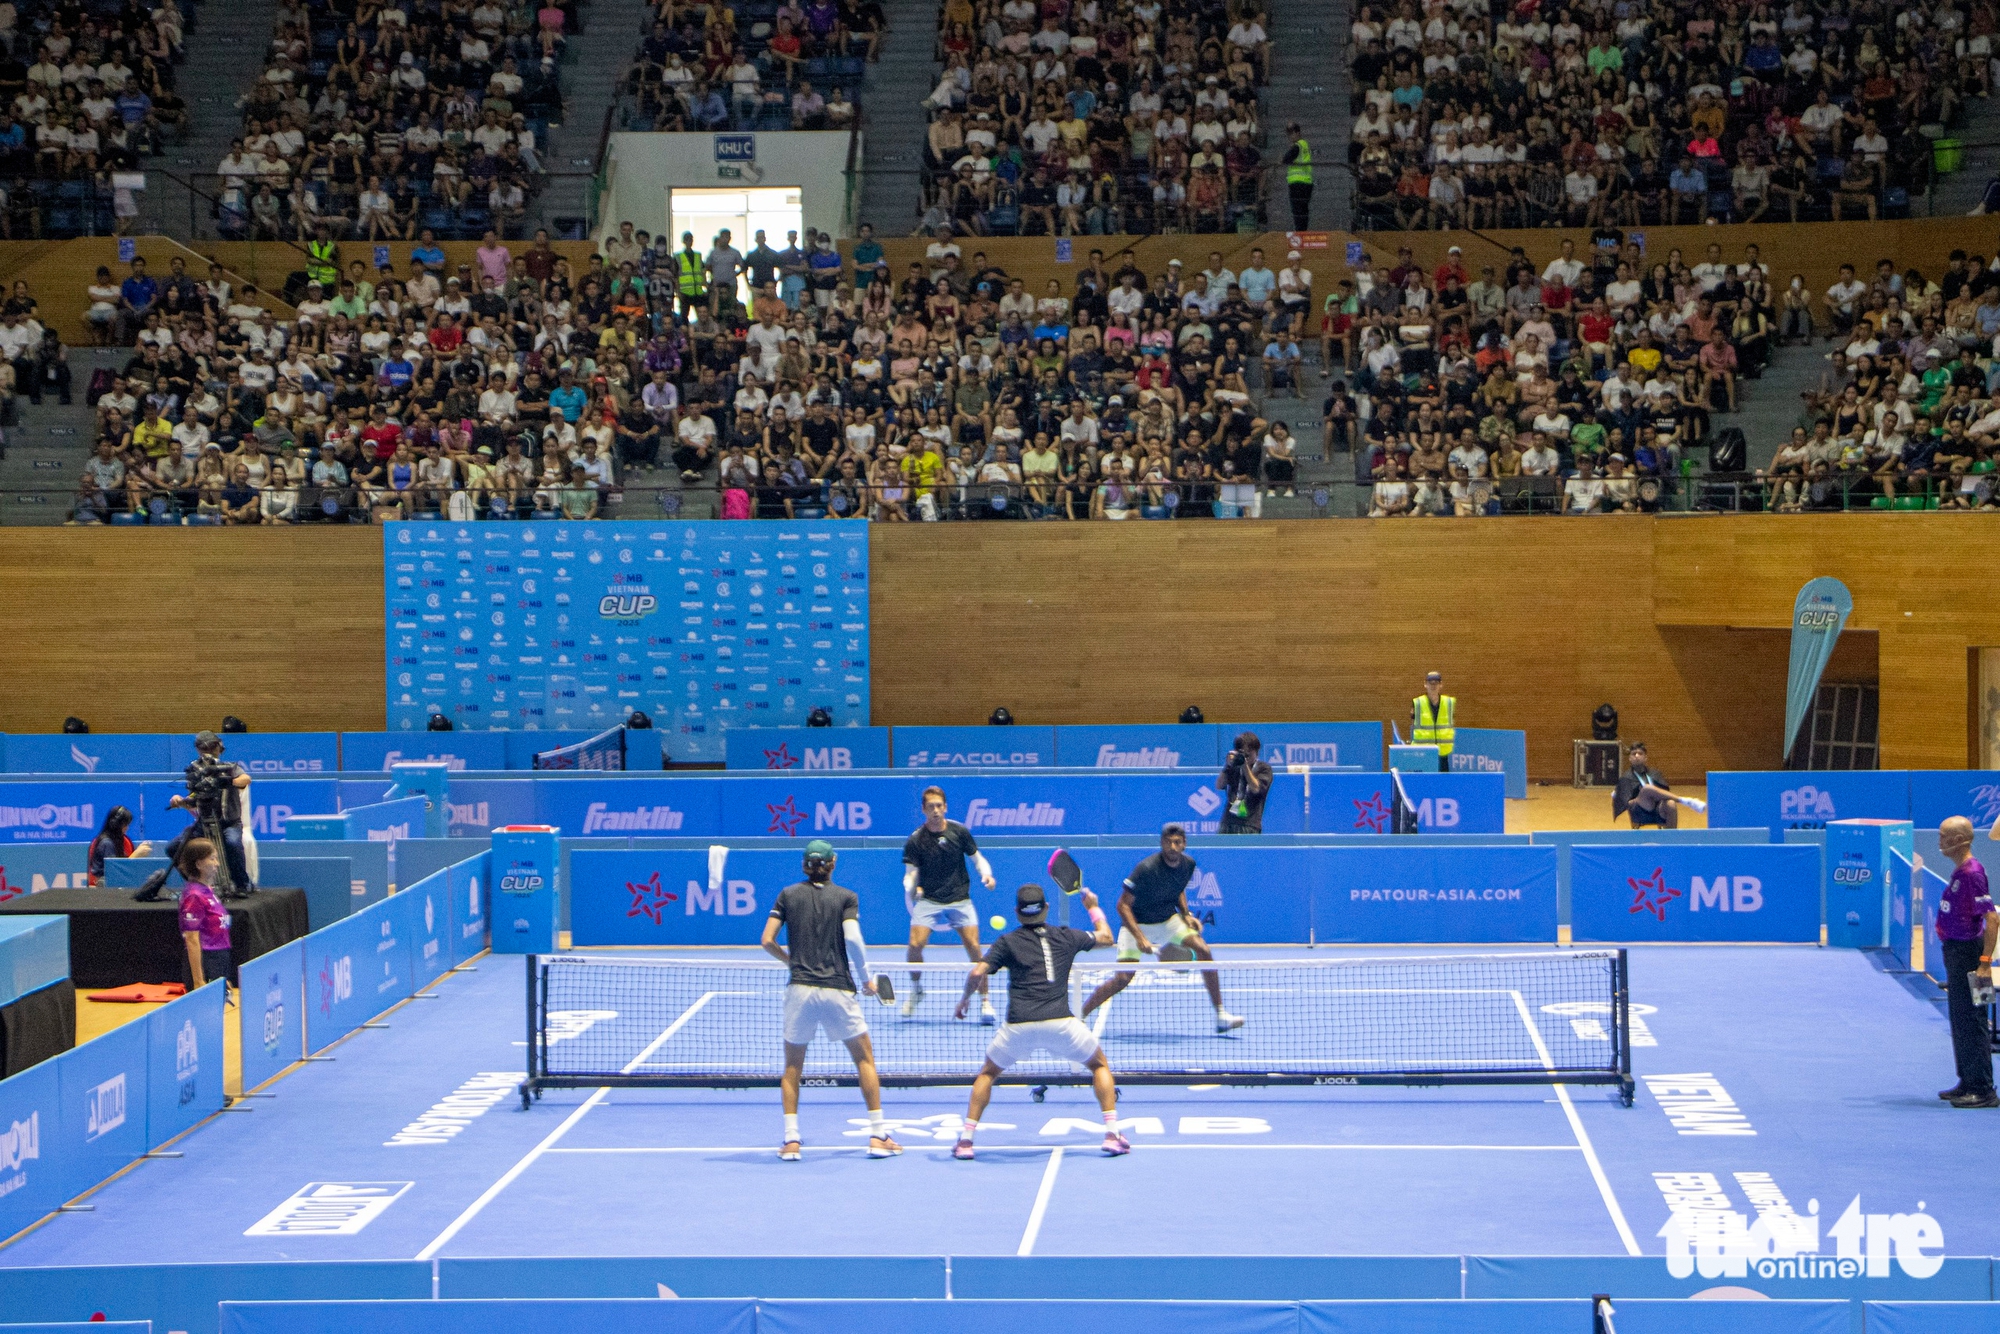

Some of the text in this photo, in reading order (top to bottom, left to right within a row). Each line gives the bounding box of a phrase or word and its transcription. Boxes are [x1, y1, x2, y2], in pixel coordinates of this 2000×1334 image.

[718, 143, 750, 155] KHU C
[626, 574, 642, 583] MB
[607, 585, 649, 594] VIETNAM
[599, 595, 655, 616] CUP
[1799, 610, 1839, 626] CUP
[804, 748, 852, 770] MB
[932, 752, 1039, 764] FACOLOS
[1290, 747, 1334, 763] JOOLA
[1452, 754, 1502, 772] FPT Play
[1780, 786, 1836, 814] PPA
[814, 802, 872, 830] MB
[41, 831, 67, 839] HILLS
[500, 876, 542, 890] CUP
[1834, 868, 1872, 882] CUP
[685, 880, 758, 916] MB
[1350, 889, 1522, 901] PPATOUR-ASIA.COM
[1689, 875, 1764, 912] MB
[333, 956, 352, 1004] MB
[1640, 1072, 1758, 1136] VIETNAM
[1038, 1116, 1273, 1134] MB
